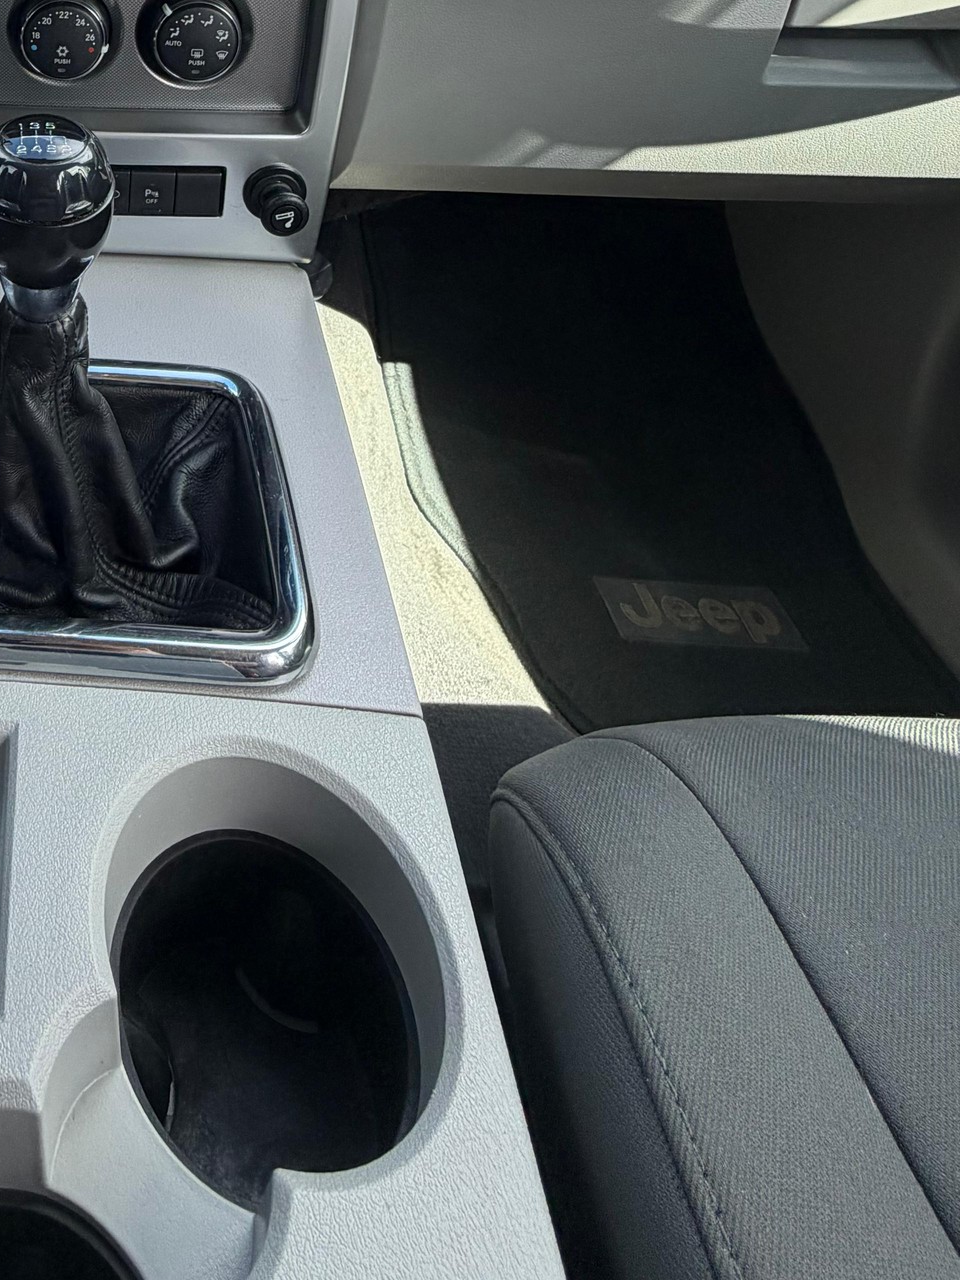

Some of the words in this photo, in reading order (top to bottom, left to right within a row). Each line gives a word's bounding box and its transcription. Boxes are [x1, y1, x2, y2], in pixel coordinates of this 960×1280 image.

[58, 11, 70, 19] 22
[41, 17, 52, 25] 20
[75, 19, 86, 27] 24
[32, 31, 41, 39] 18
[85, 34, 96, 42] 26
[30, 145, 42, 153] 4
[618, 582, 782, 645] Jeep
